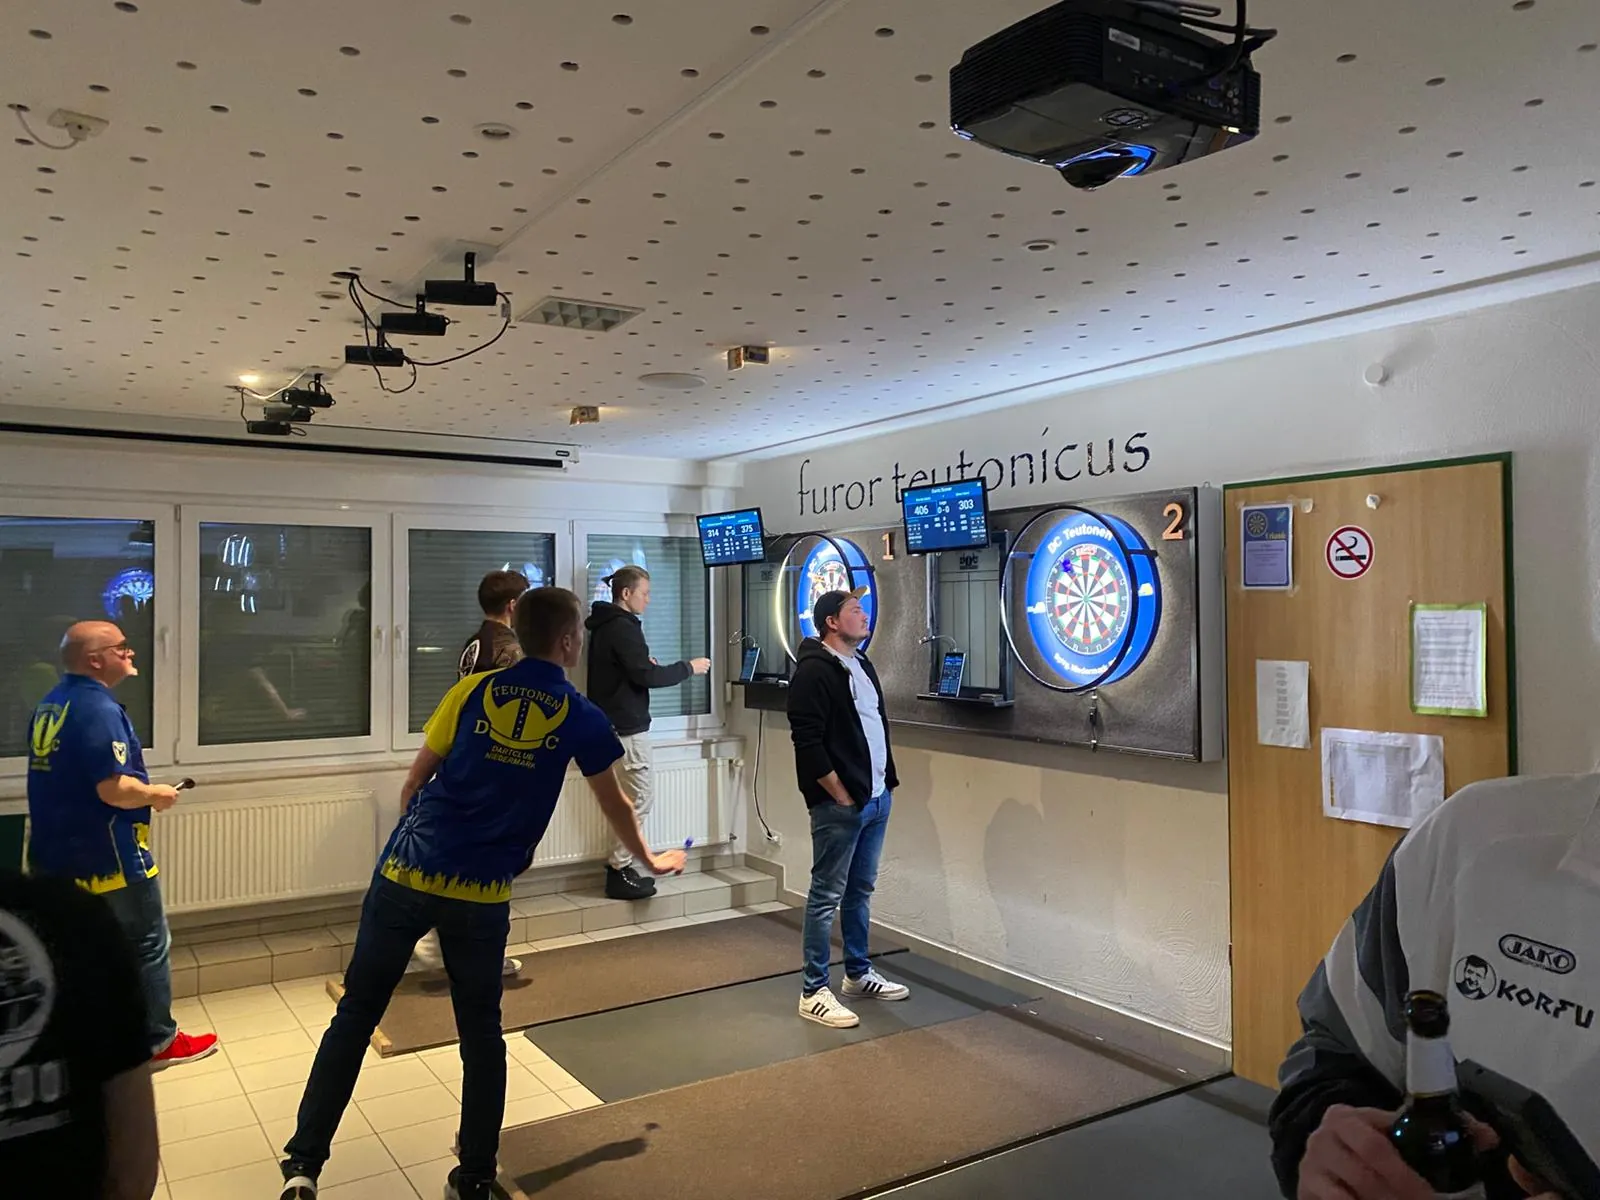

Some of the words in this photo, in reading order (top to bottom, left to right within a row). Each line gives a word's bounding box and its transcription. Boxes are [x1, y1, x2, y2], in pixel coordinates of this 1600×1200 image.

[797, 459, 883, 516] furor
[914, 504, 929, 515] 406
[958, 499, 974, 510] 303
[1162, 502, 1184, 540] 2
[741, 524, 753, 533] 375
[1047, 536, 1062, 554] DC
[1063, 523, 1113, 541] Teutonen
[882, 532, 895, 561] 1
[493, 685, 561, 710] TEUTONEN
[473, 719, 489, 734] D
[545, 735, 560, 750] C
[485, 752, 535, 769] NIEDERMARK
[491, 745, 534, 760] DARTCLUB
[1507, 941, 1570, 969] JAKO
[1497, 979, 1594, 1029] KORFU
